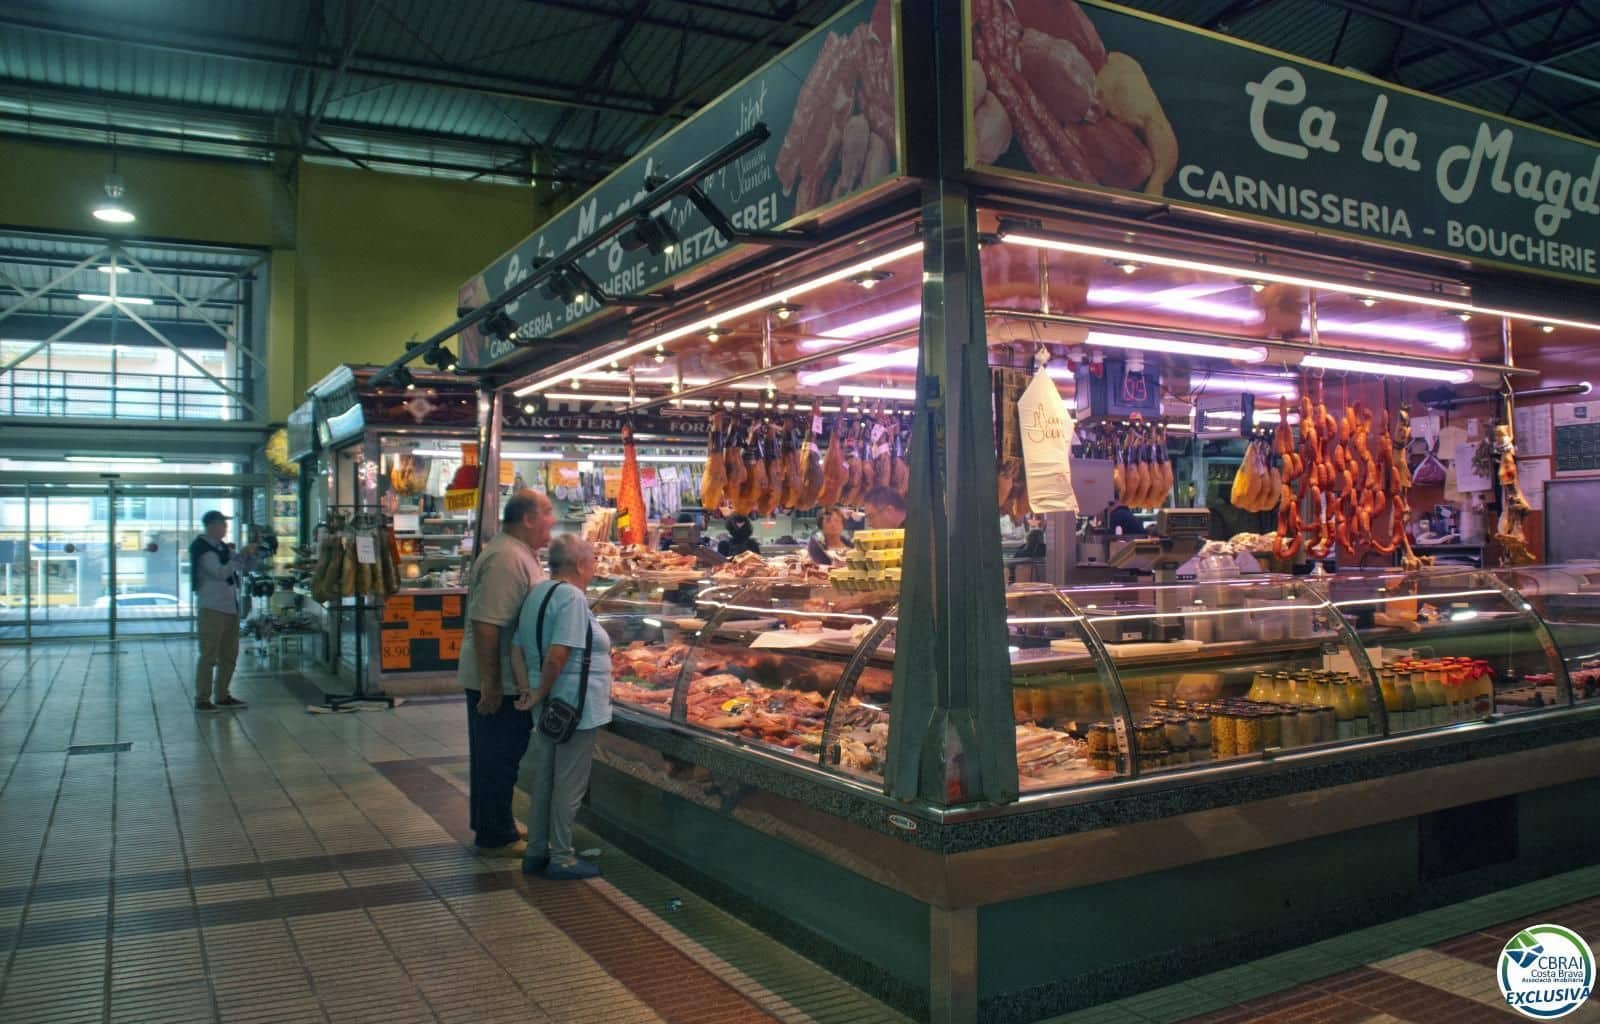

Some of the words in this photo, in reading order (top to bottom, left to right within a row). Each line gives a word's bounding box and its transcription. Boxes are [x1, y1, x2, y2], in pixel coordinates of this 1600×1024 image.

[1246, 66, 1340, 160] Ca
[1361, 94, 1421, 172] la
[1178, 165, 1413, 239] CARNISSERIA
[1447, 220, 1597, 274] BOUCHERIE
